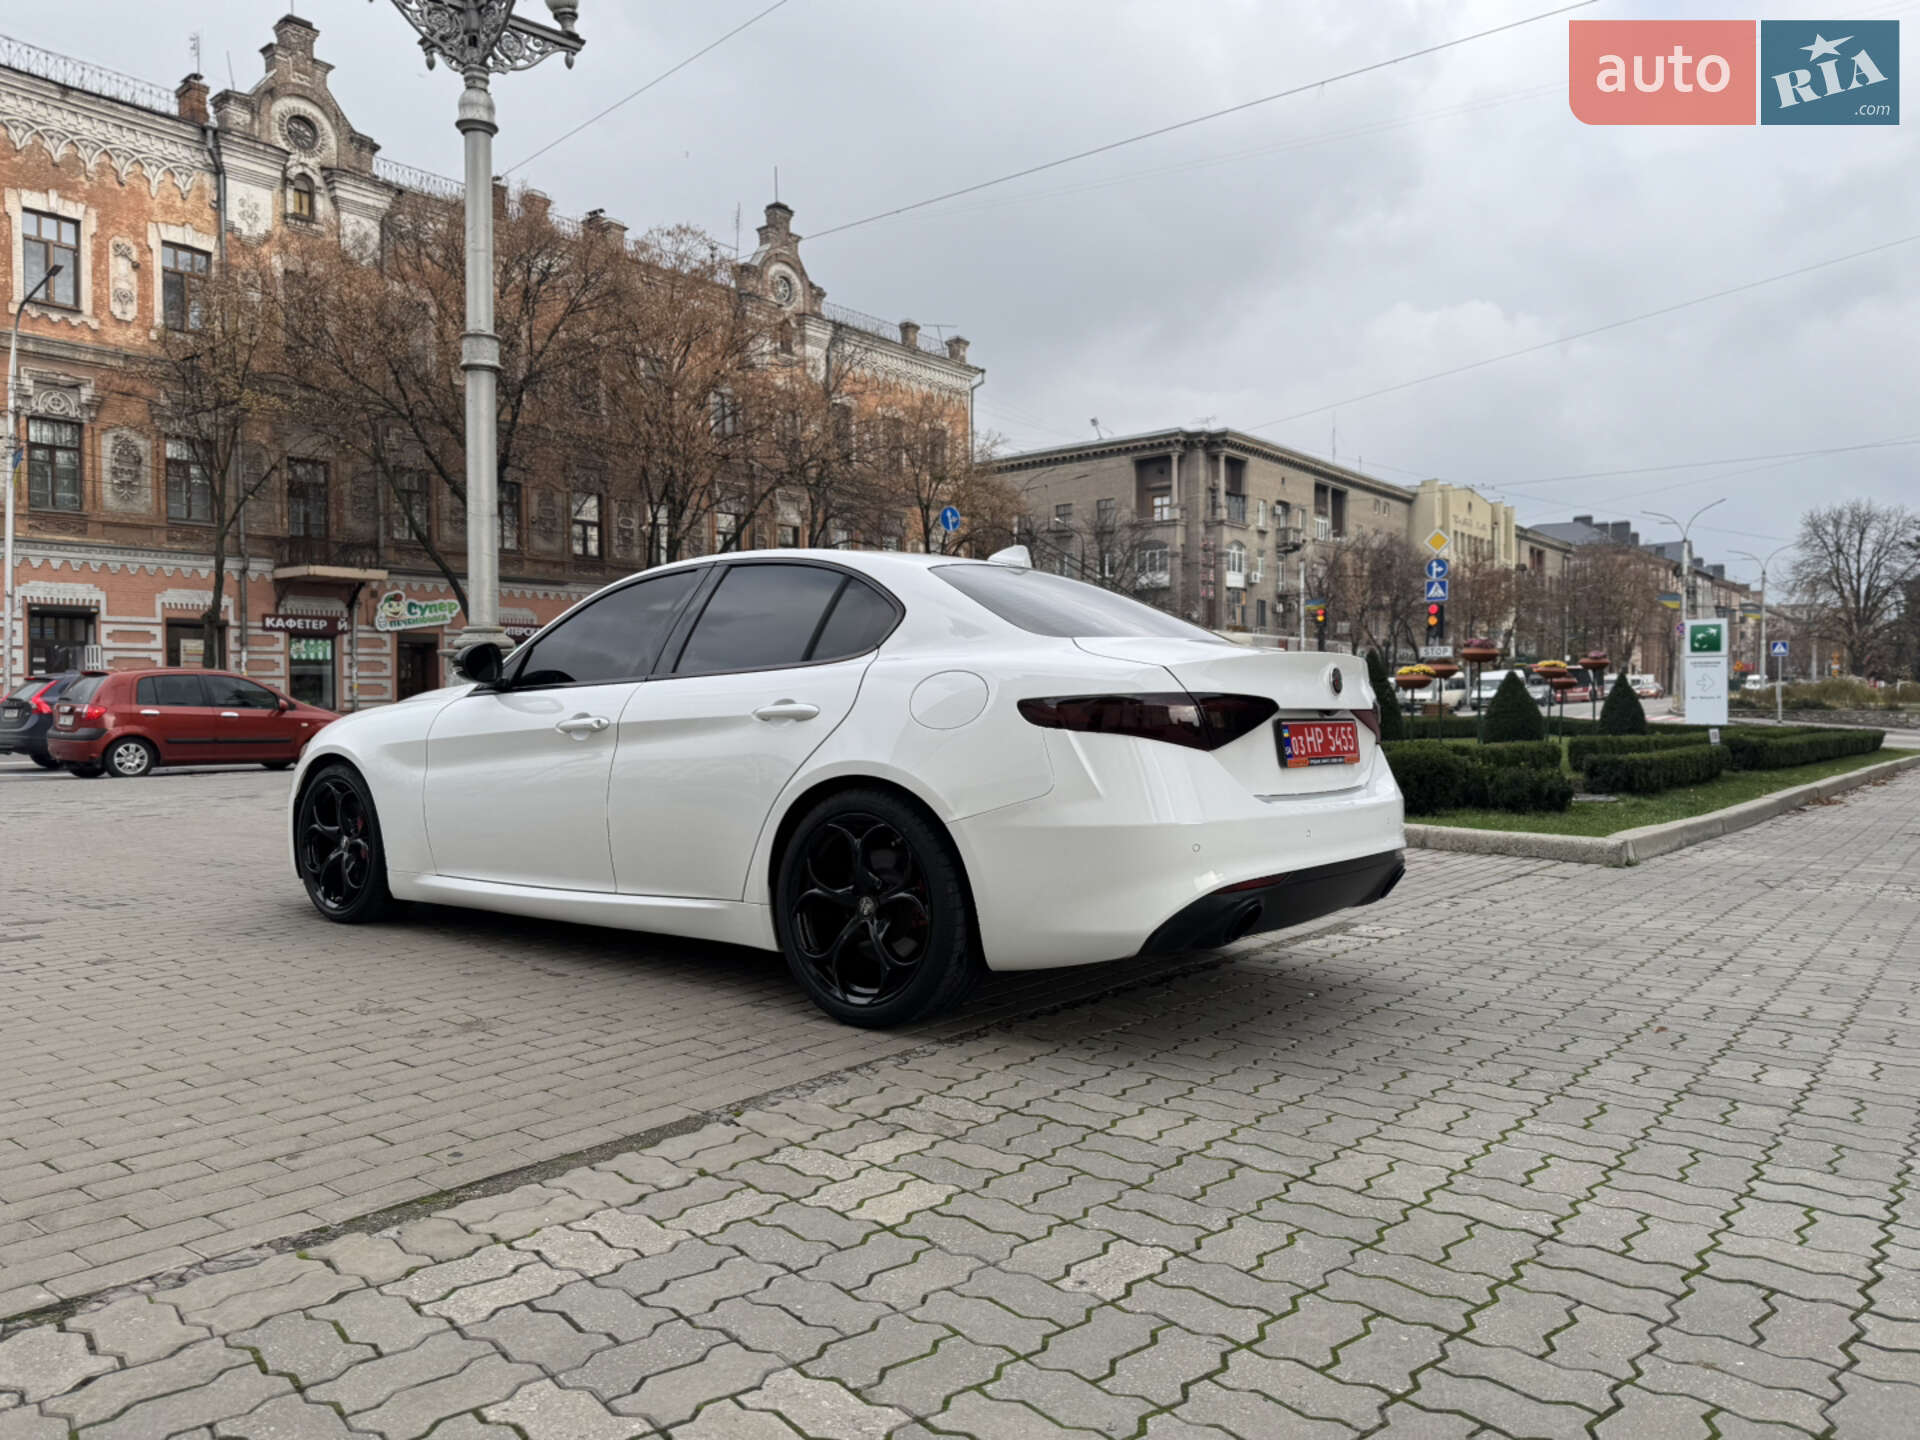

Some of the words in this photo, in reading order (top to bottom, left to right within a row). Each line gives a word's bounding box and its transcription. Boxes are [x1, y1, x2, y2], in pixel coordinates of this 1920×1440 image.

[407, 601, 459, 617] Супер
[1423, 647, 1449, 656] STOP
[1327, 726, 1355, 752] 5455
